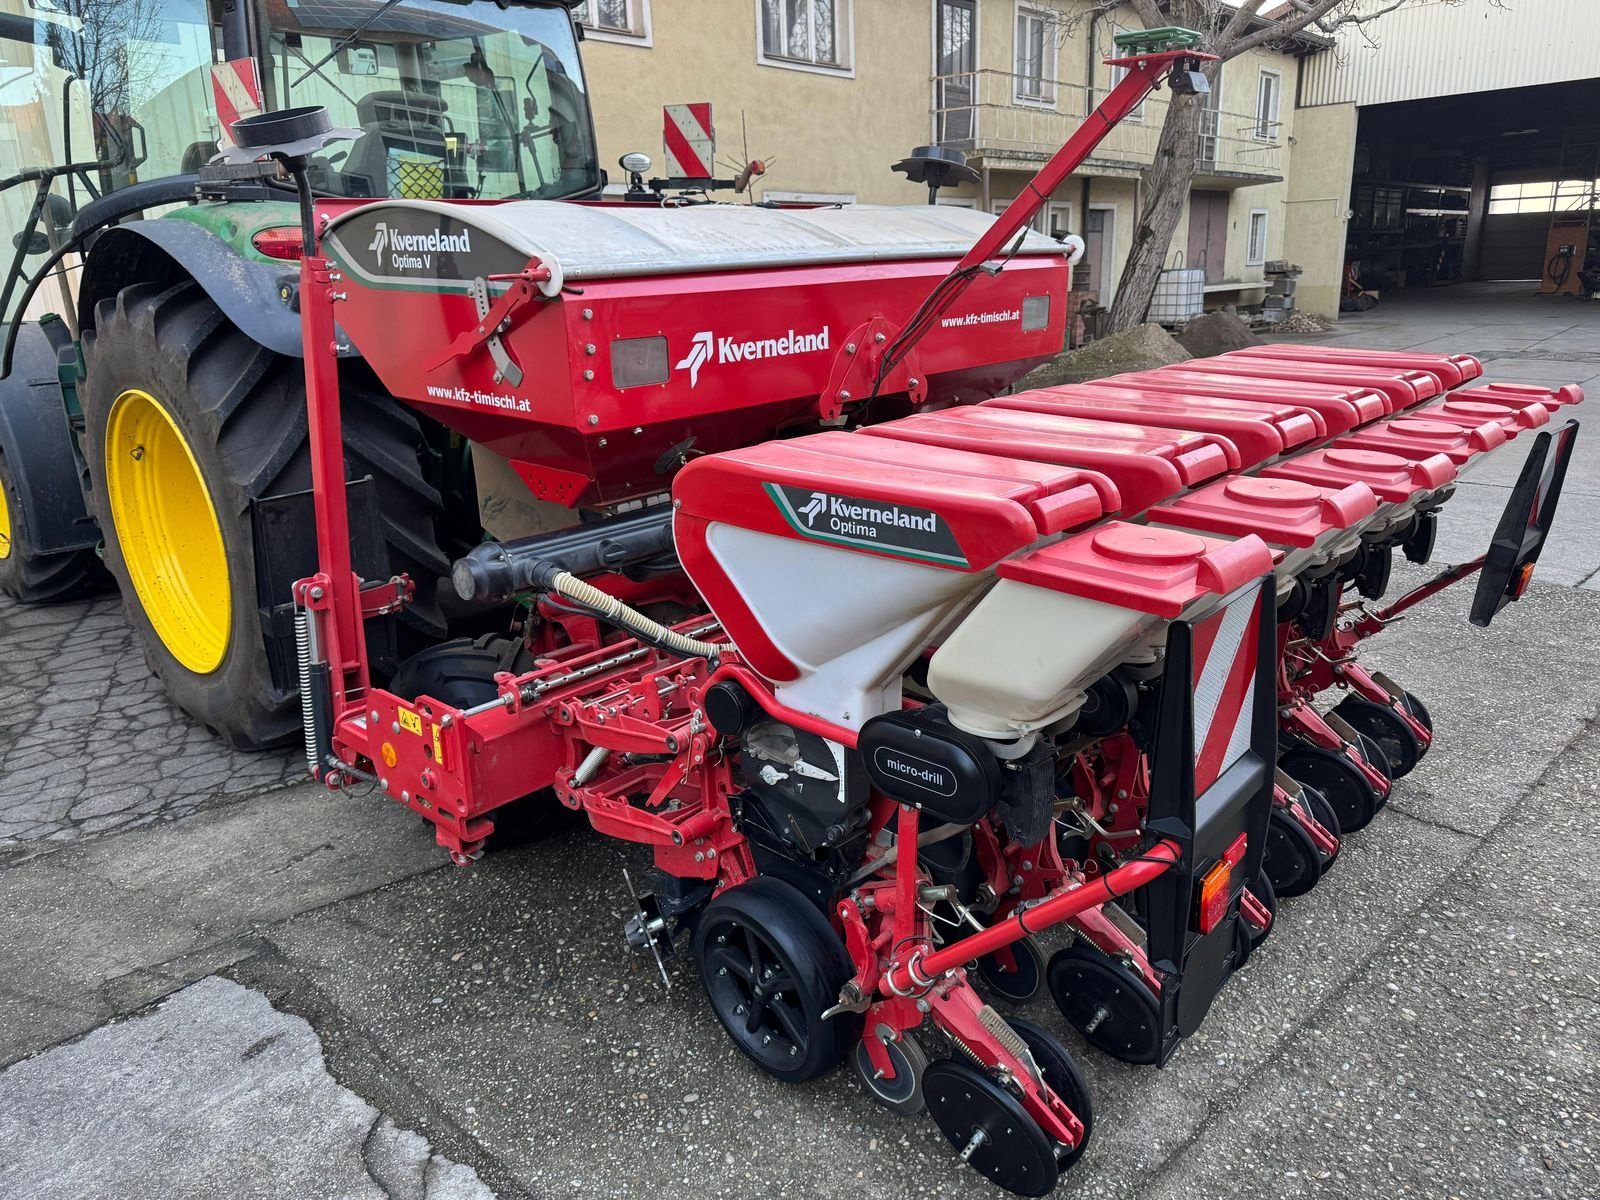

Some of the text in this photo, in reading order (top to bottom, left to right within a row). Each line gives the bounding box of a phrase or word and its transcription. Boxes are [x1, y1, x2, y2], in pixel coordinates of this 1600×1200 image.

[389, 228, 471, 253] Kverneland
[391, 254, 432, 270] Optima V
[941, 310, 1020, 328] www.kfz-timischl.at
[717, 325, 830, 364] Kverneland
[426, 386, 531, 412] www.kfz-timischl.at
[829, 496, 937, 533] Kverneland
[829, 518, 878, 539] Optima
[886, 758, 944, 786] micro-drill
